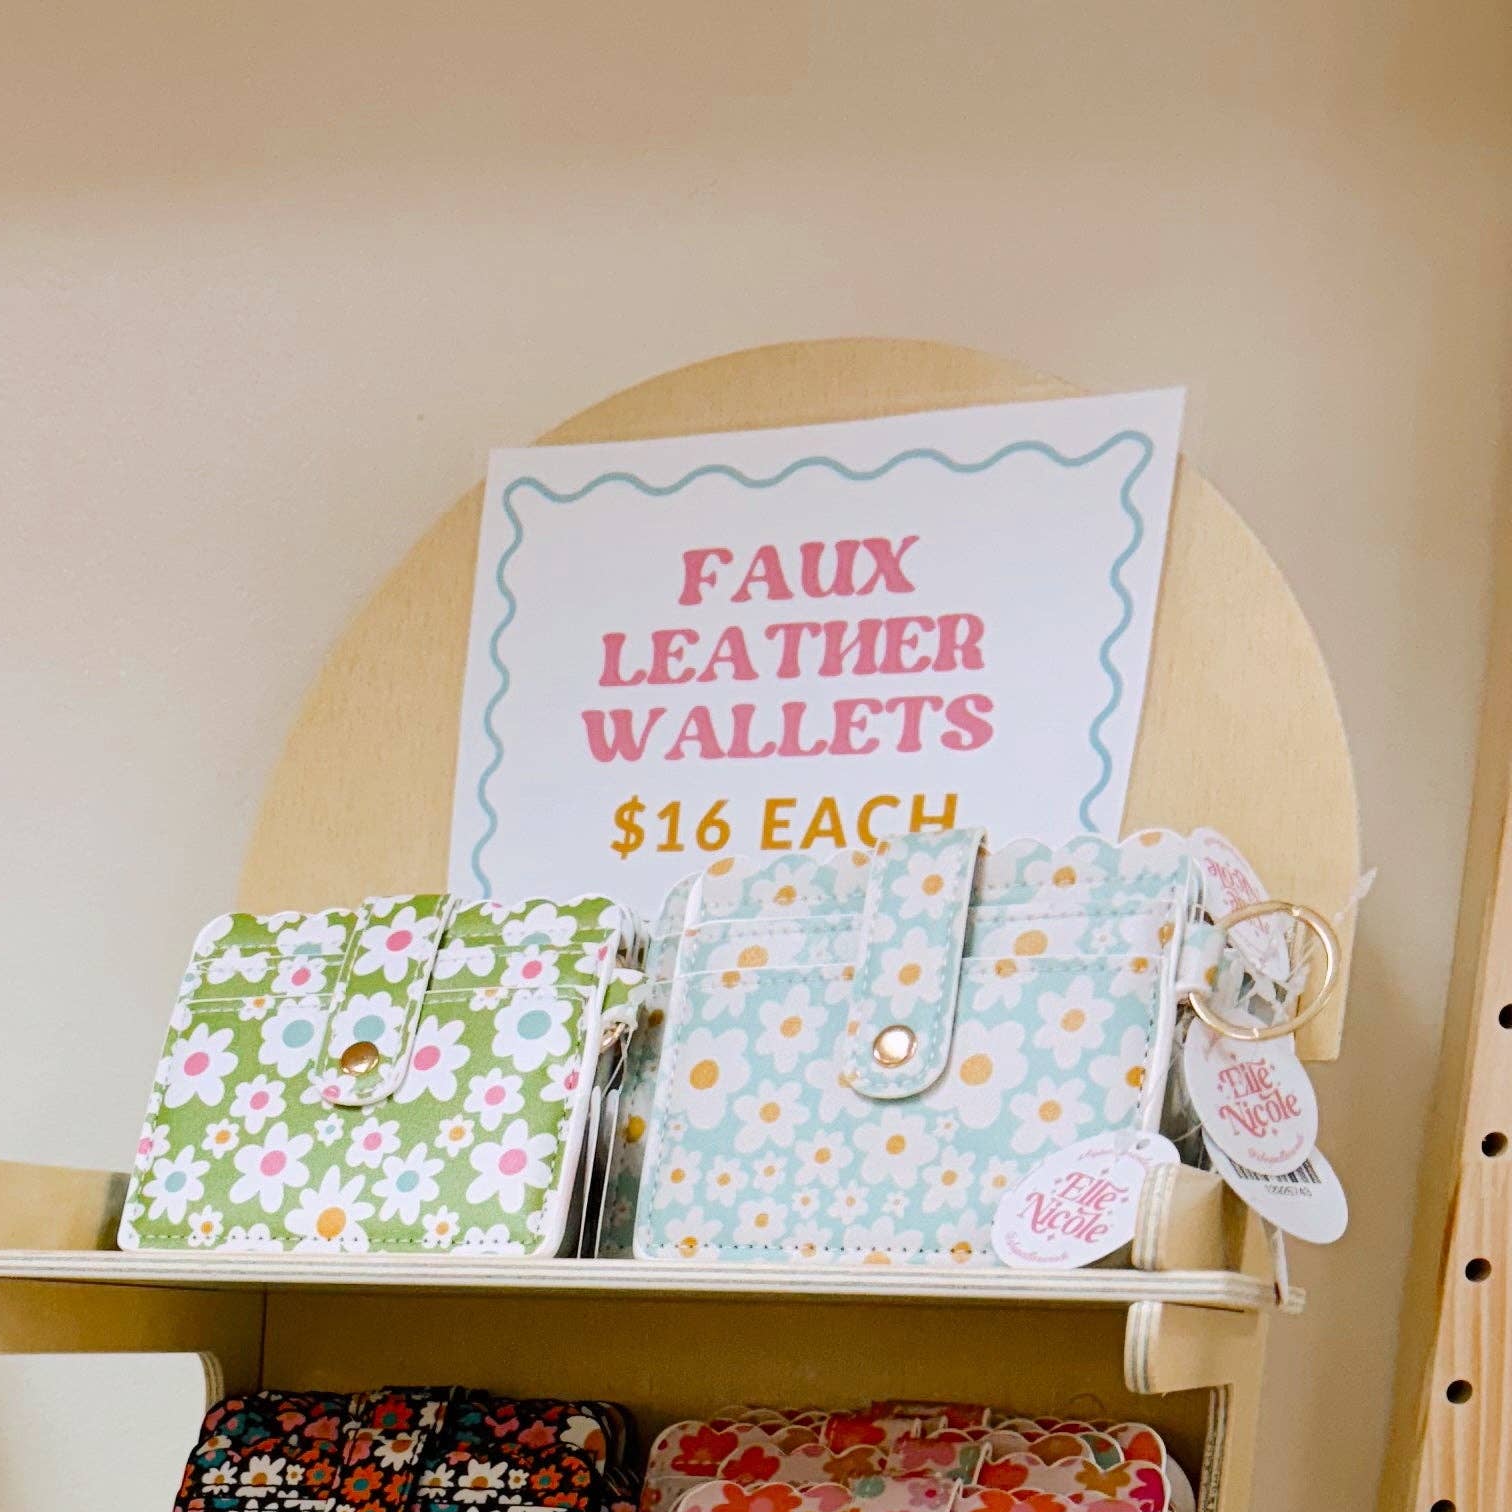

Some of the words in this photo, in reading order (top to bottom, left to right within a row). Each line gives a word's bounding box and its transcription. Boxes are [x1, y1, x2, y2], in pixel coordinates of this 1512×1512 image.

[678, 535, 920, 606] FAUX
[598, 612, 985, 687] LEATHER
[581, 693, 994, 763] WALLETS
[610, 795, 731, 860] $16
[760, 793, 958, 853] EACH
[1219, 1088, 1302, 1137] Nicole
[1017, 1192, 1109, 1244] Nicole
[1058, 1171, 1128, 1211] Elle
